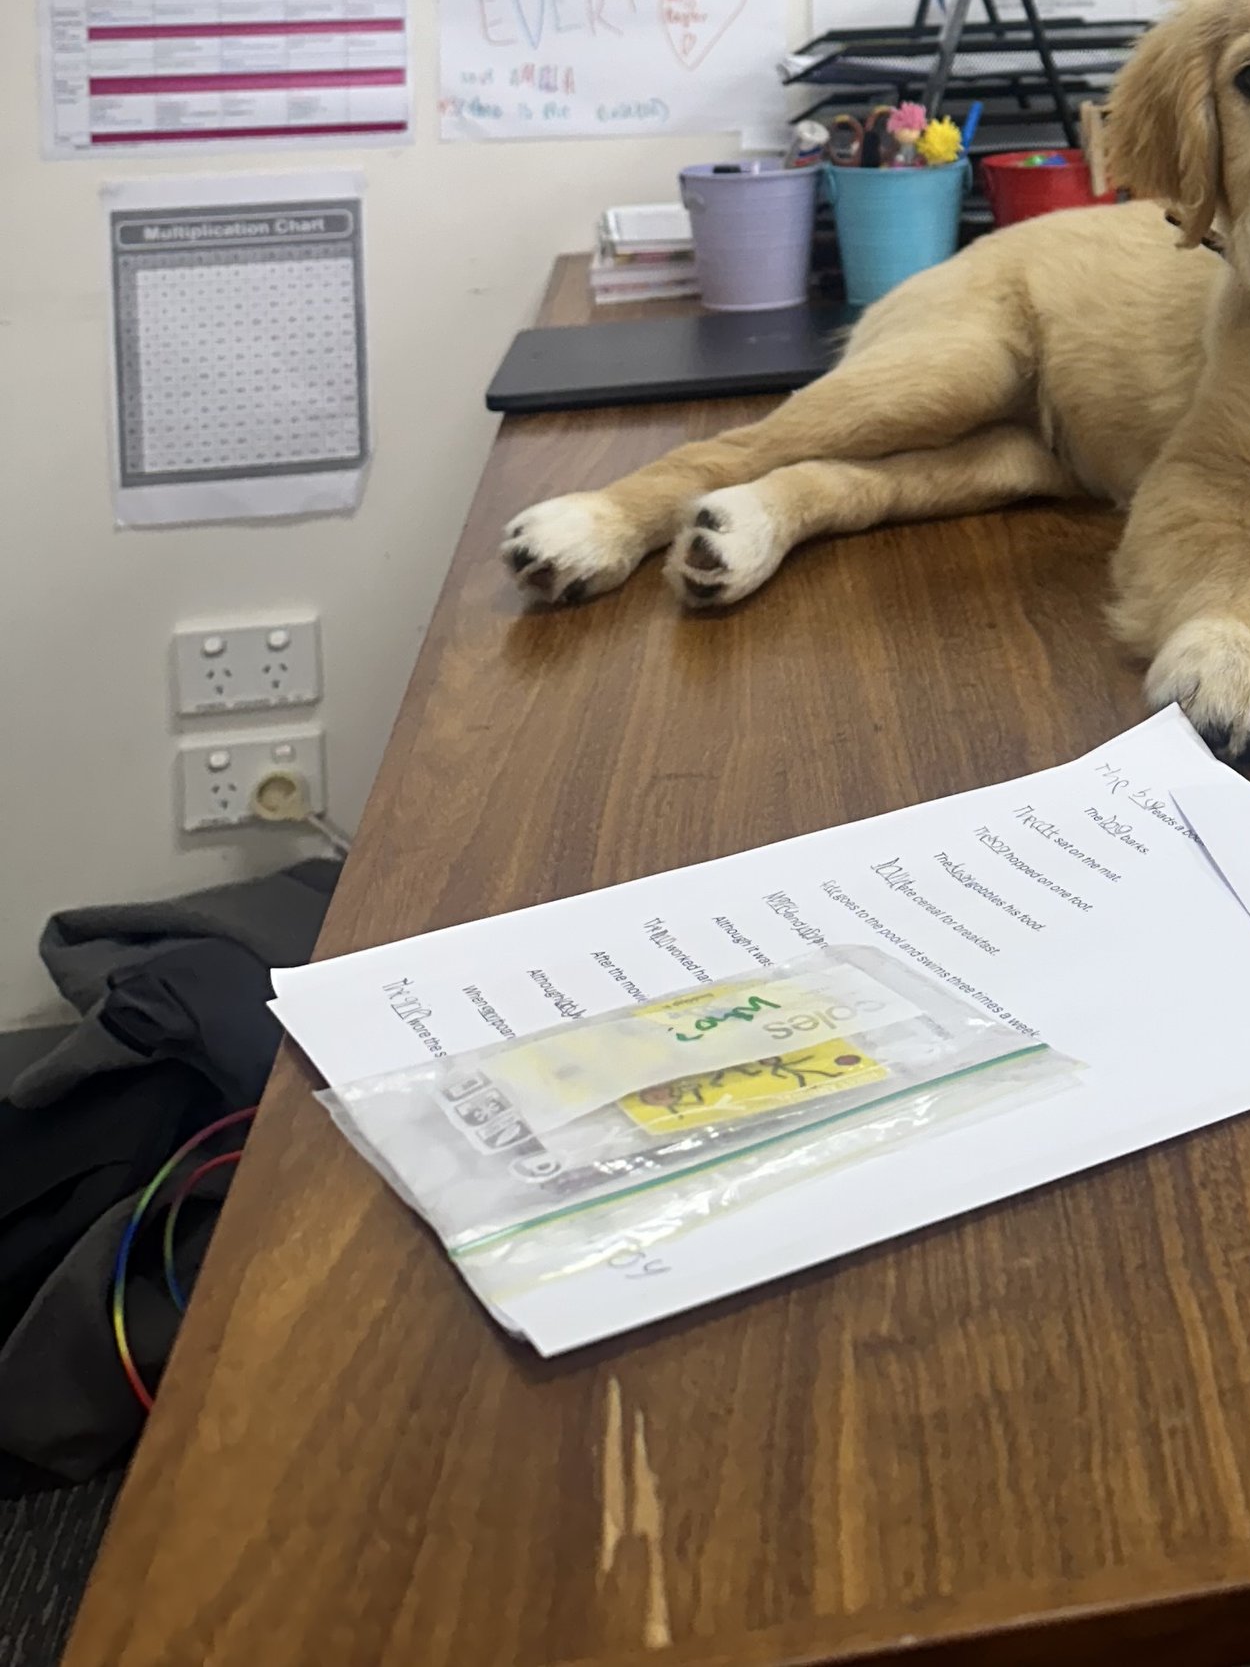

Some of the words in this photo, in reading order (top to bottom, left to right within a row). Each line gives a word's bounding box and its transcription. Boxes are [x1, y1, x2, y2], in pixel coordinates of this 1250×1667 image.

[143, 221, 270, 240] Multiplication
[275, 218, 325, 233] Chart
[1084, 807, 1104, 822] The
[1120, 834, 1150, 855] barks.
[1053, 837, 1073, 850] sat
[1068, 847, 1085, 860] on
[1082, 856, 1101, 870] the
[1098, 867, 1122, 883] mat.
[933, 851, 953, 868] The
[1002, 903, 1021, 917] his
[1018, 913, 1047, 932] food.
[1003, 851, 1044, 880] hopped
[1037, 876, 1053, 887] on
[1050, 885, 1072, 899] one
[1068, 896, 1093, 913] foot.
[912, 895, 947, 918] cereal
[940, 915, 959, 926] for
[712, 915, 752, 950] Although
[590, 951, 616, 970] After
[608, 967, 628, 983] the
[665, 940, 705, 975] worked
[855, 909, 870, 920] to
[865, 917, 884, 931] the
[877, 928, 907, 946] pool
[899, 942, 926, 959] and
[916, 955, 951, 979] swims
[948, 974, 976, 995] three
[971, 990, 1005, 1014] times
[407, 1017, 432, 1039] wore
[423, 1034, 443, 1052] the
[762, 999, 886, 1040] coles
